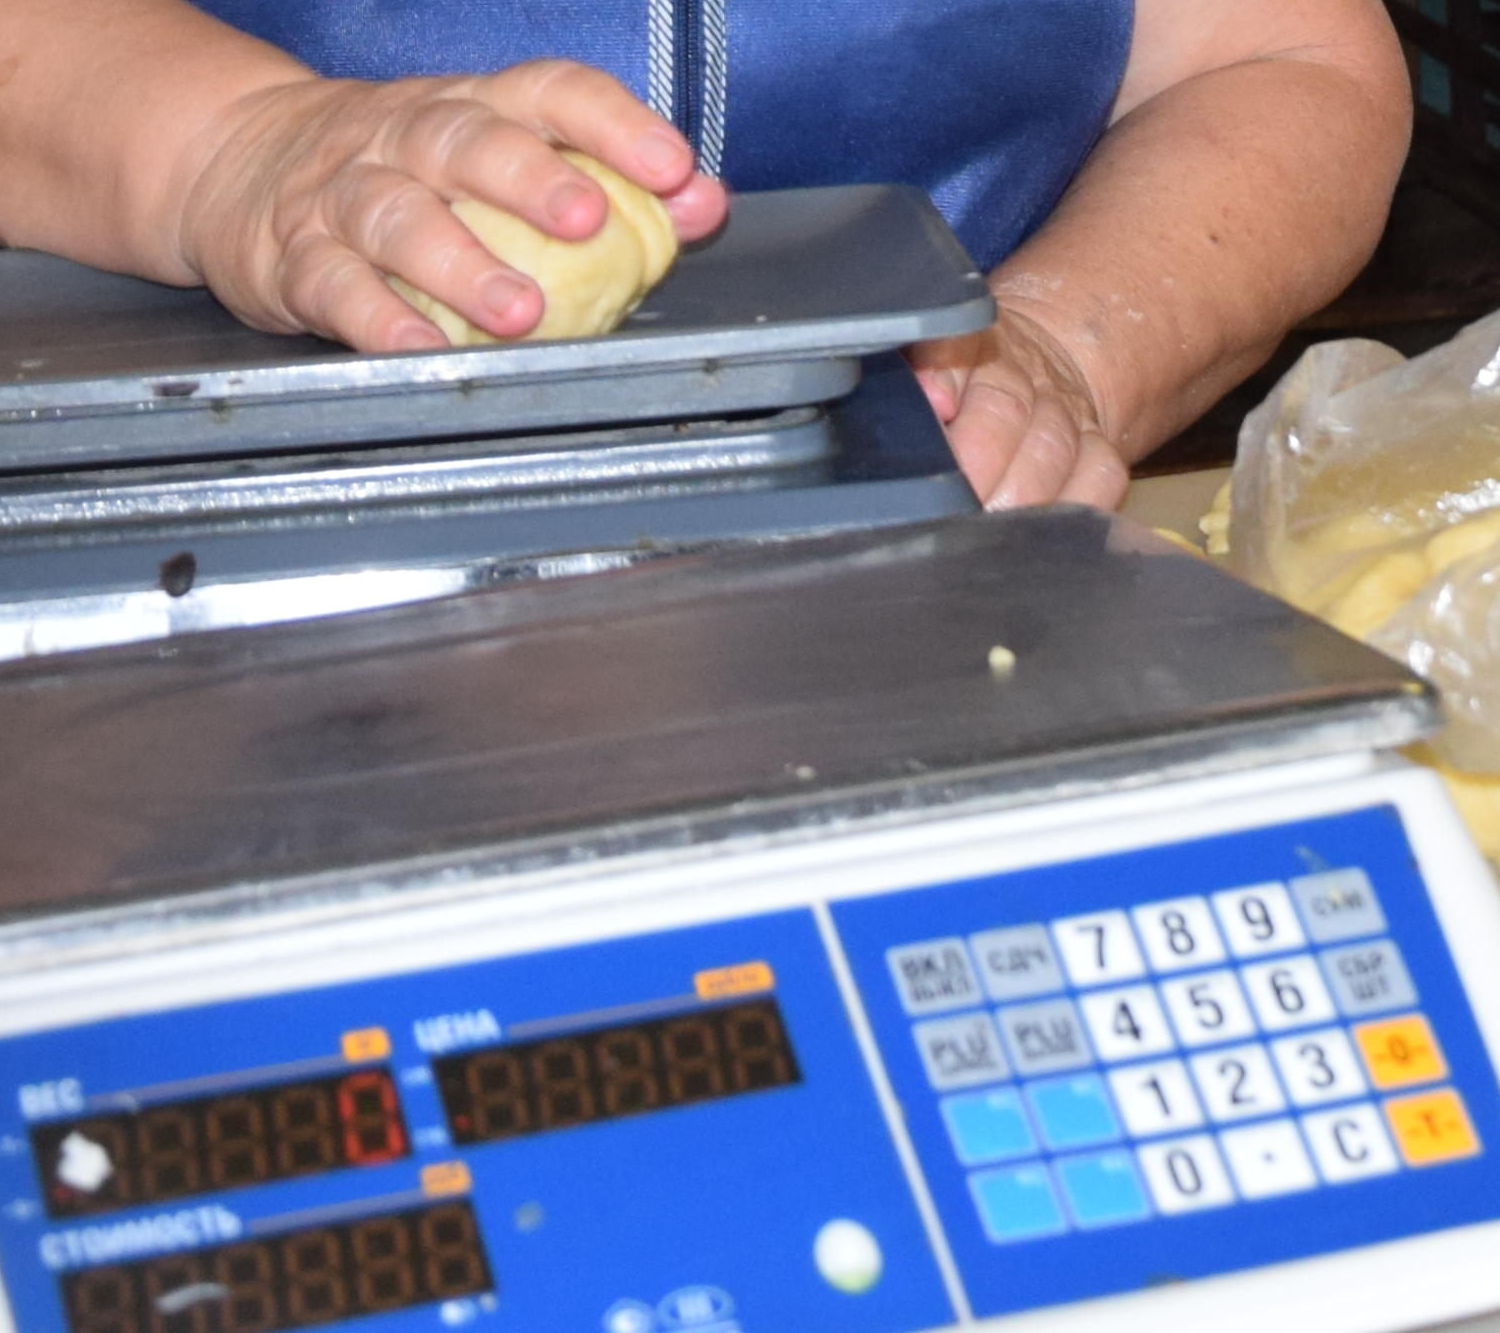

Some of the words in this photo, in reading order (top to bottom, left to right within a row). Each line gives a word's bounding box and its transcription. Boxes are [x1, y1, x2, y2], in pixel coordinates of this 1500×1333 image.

[1162, 911, 1194, 955] 8
[1241, 897, 1274, 941] 9
[1075, 925, 1105, 968] 7
[1189, 983, 1223, 1028] 5
[1270, 970, 1304, 1013] 6
[413, 1008, 499, 1053] ЦЕНА
[1113, 1001, 1141, 1041] 4
[1219, 1060, 1256, 1105] 2
[1300, 1042, 1335, 1088] 3
[18, 1077, 84, 1121] ВЕС
[339, 1070, 408, 1165] 0
[1142, 1074, 1170, 1118] 1
[1333, 1119, 1368, 1164] C
[1166, 1148, 1202, 1195] 0
[39, 1203, 243, 1270] СТОИМОСТЬ
